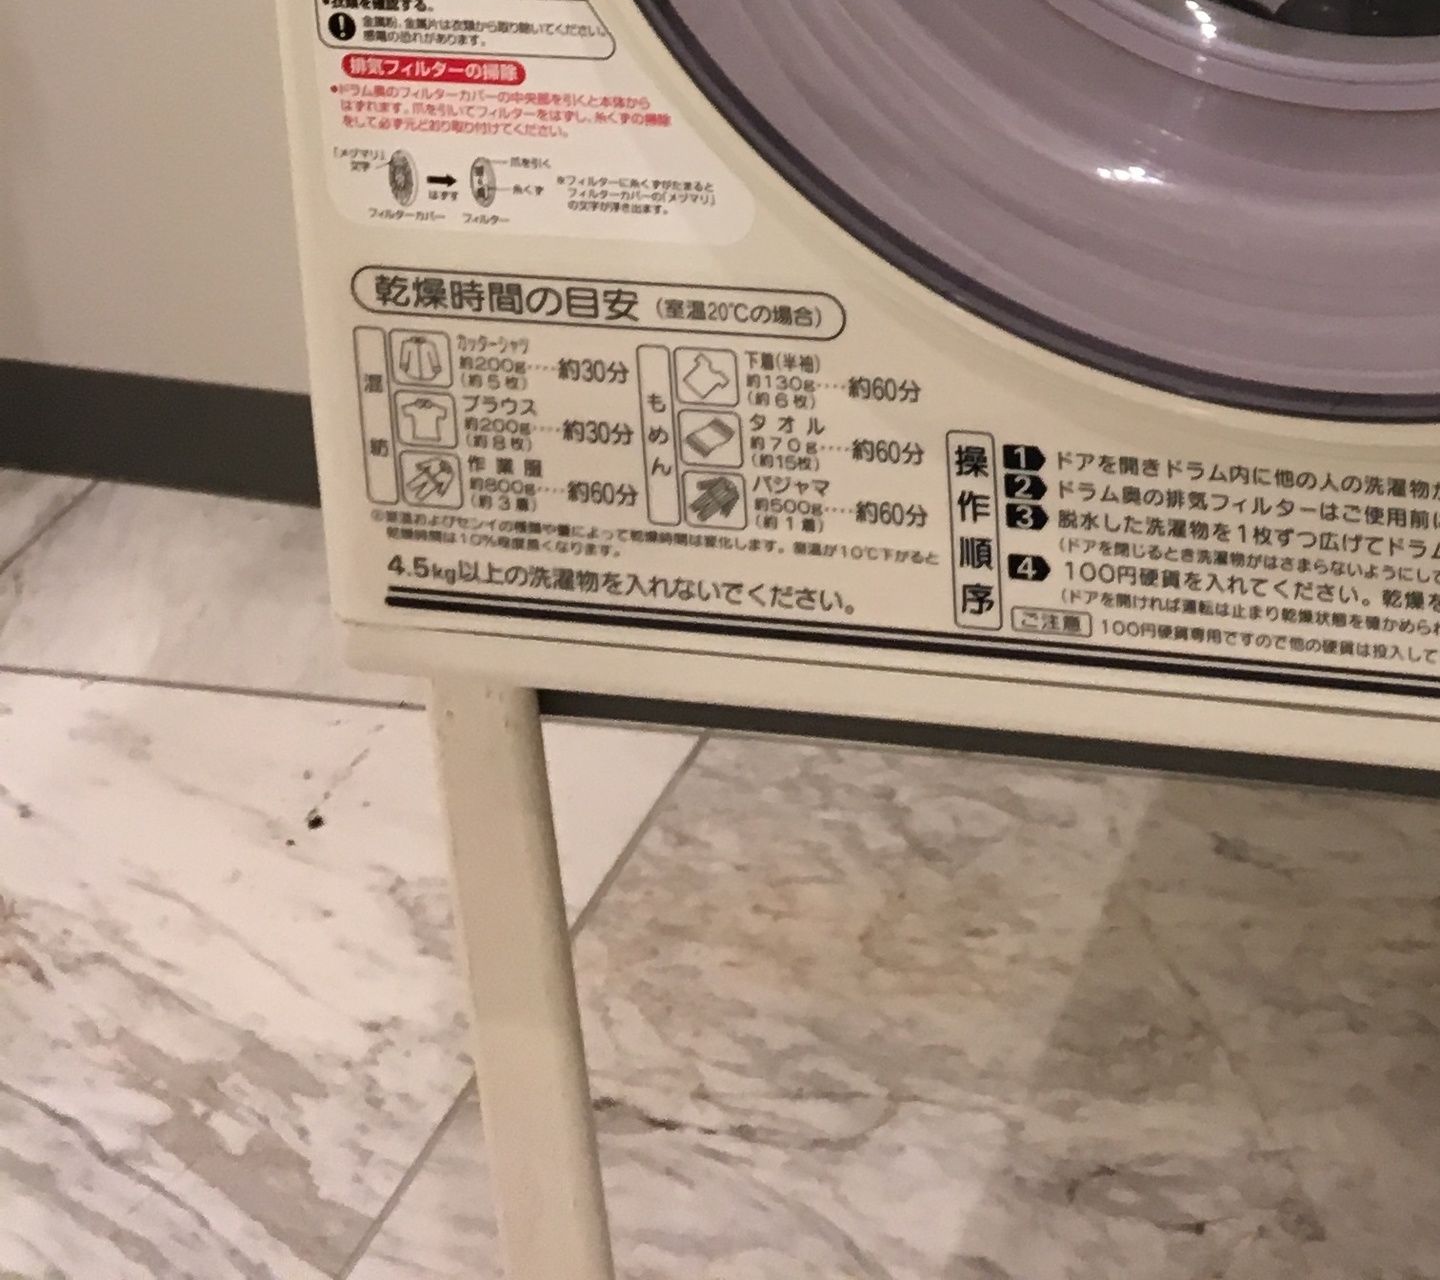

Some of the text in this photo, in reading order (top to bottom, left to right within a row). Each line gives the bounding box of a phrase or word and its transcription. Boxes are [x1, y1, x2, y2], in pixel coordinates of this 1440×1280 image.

[349, 56, 518, 83] 排気フィルターの掃除
[462, 213, 511, 226] フィルター
[374, 274, 640, 323] 乾燥時間の目安
[557, 357, 630, 385] 約30分
[848, 376, 922, 404] 約60分
[463, 394, 538, 416] ブラウス
[562, 418, 635, 446] 約30分
[646, 393, 673, 477] もめん
[750, 414, 826, 436] タオル
[852, 438, 925, 466] 約60分
[567, 480, 639, 507] 約60分
[855, 500, 929, 528] 約60分
[954, 443, 995, 616] 操作順序
[387, 553, 856, 617] 4.5kg以上の洗濯物を入れないでください。
[1020, 612, 1082, 633] ご注意
